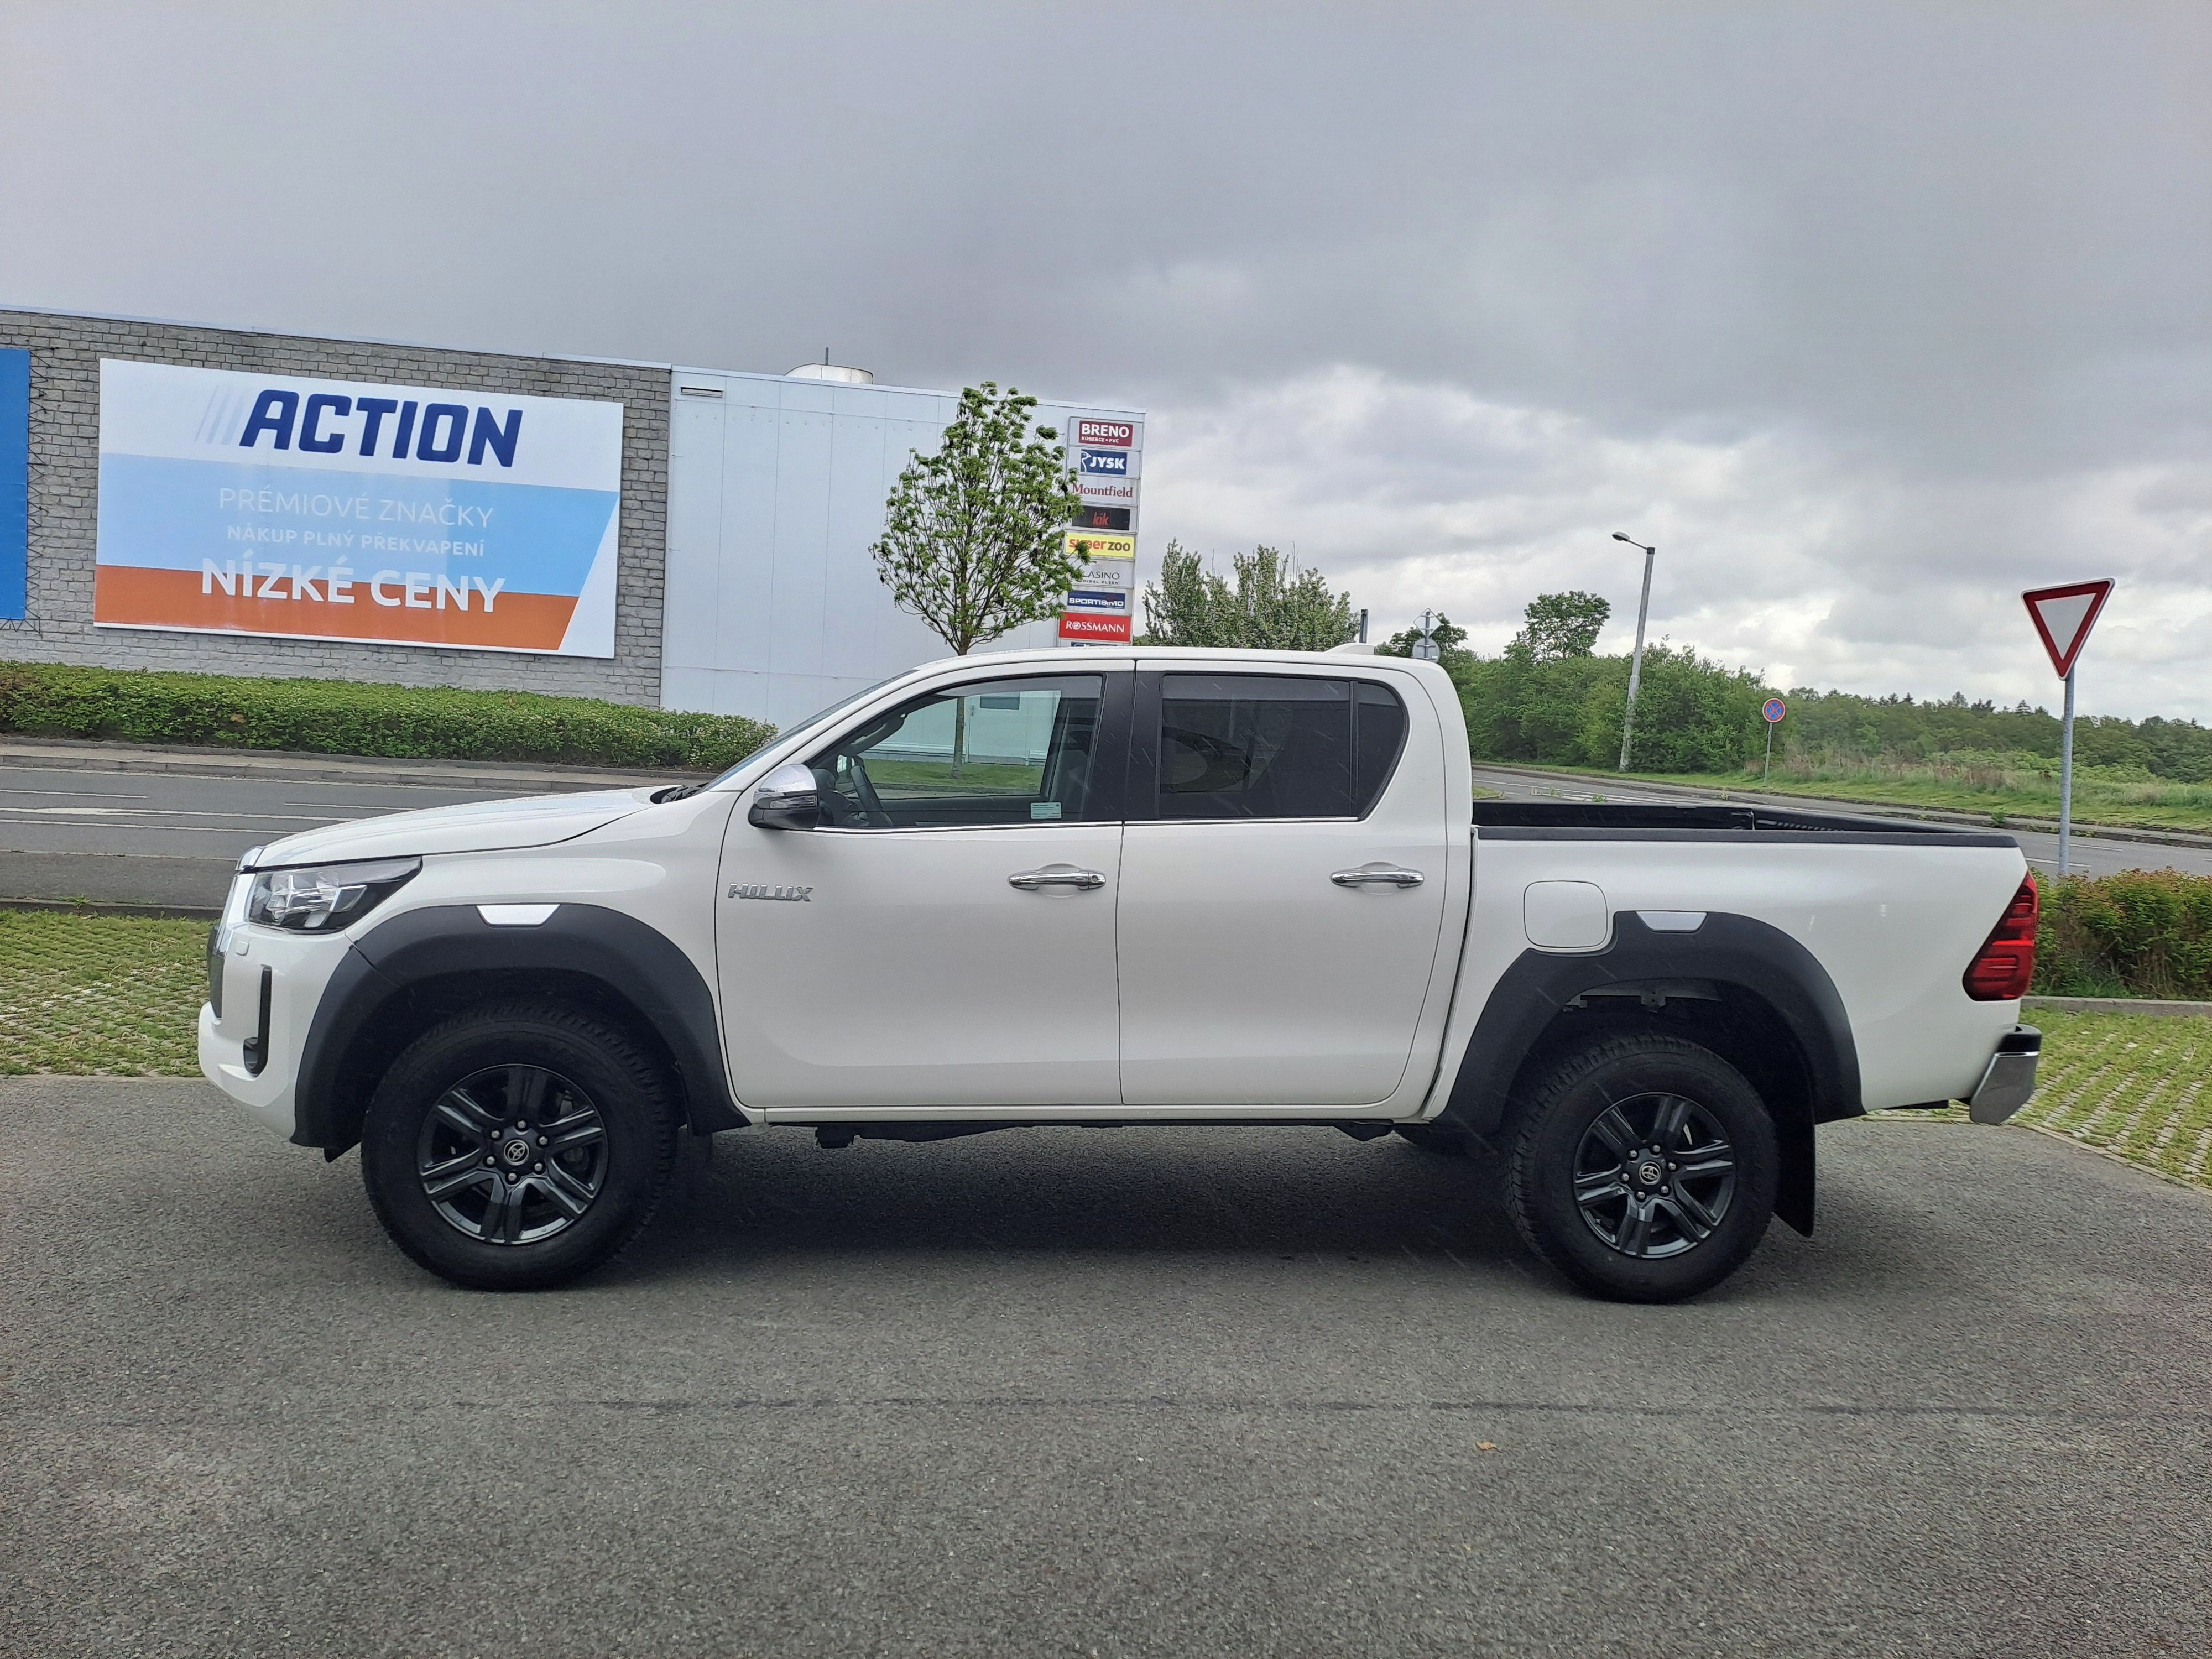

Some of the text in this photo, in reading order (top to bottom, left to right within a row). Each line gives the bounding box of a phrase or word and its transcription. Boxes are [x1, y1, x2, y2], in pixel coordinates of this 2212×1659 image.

[239, 389, 524, 468] ACTION
[1082, 423, 1129, 438] BRENO
[1090, 456, 1125, 469] JYSK
[1073, 483, 1133, 498] Mountfield
[220, 486, 494, 528] PRÉMIOVÉ ZNAČKY
[227, 523, 484, 557] NÁKUP PLNÝ PŘEKVAPENÍ
[201, 548, 507, 613] NÍZKÉ CENY
[1078, 571, 1120, 580] ASINO
[1066, 620, 1125, 633] ROSSMANN
[728, 883, 814, 901] HILUX
